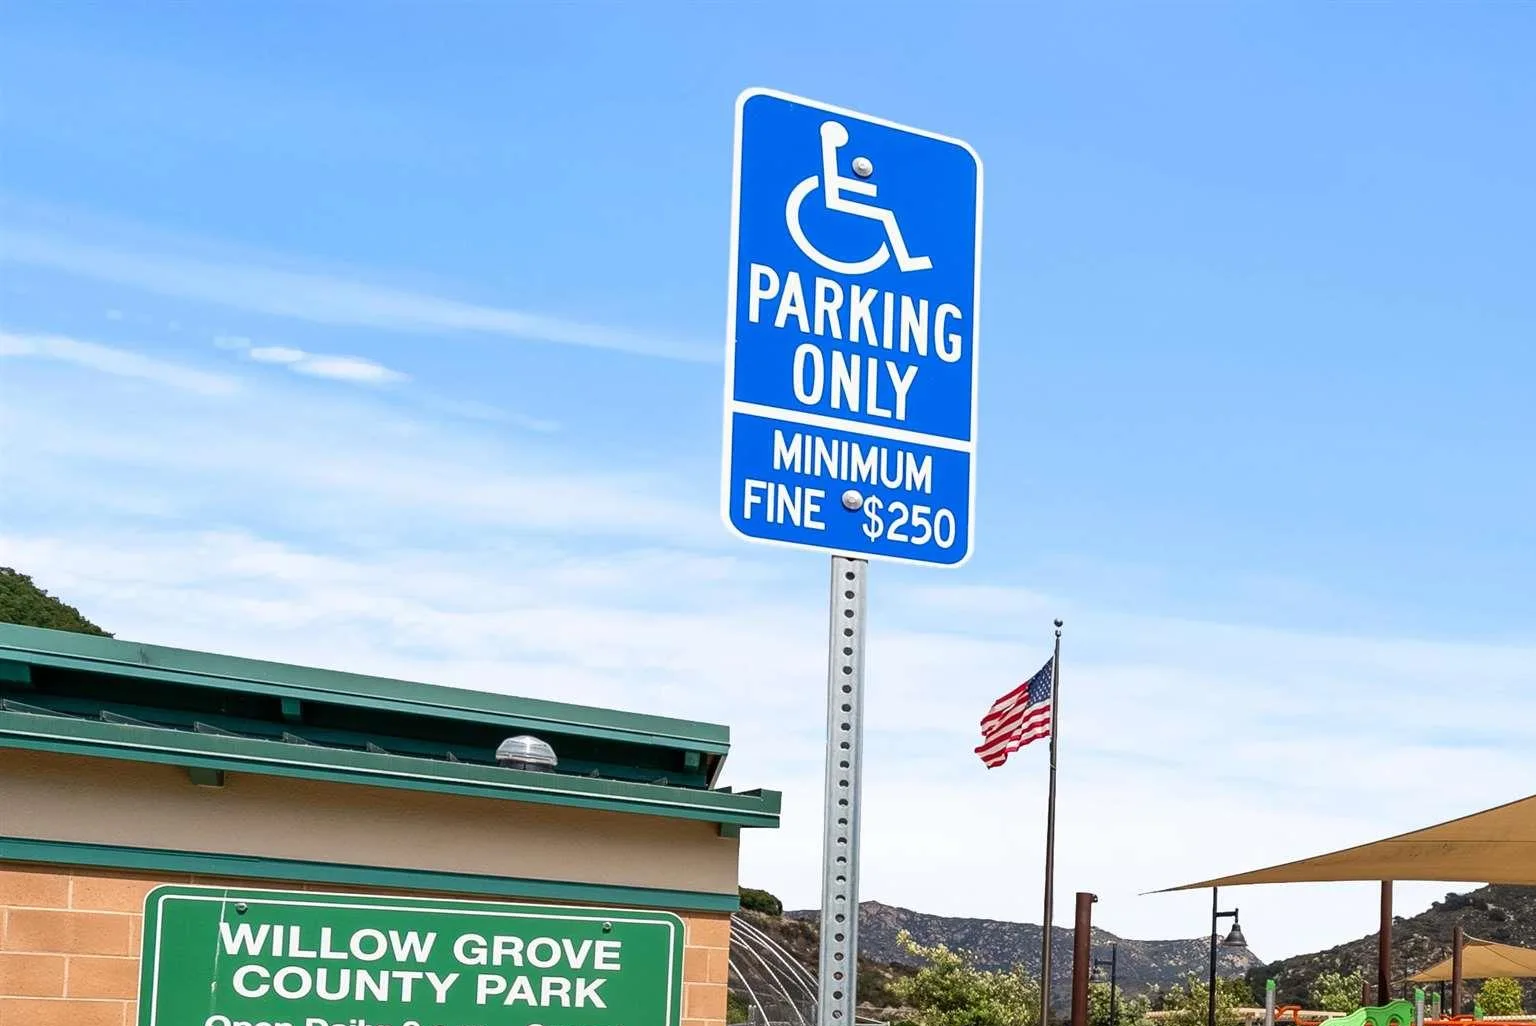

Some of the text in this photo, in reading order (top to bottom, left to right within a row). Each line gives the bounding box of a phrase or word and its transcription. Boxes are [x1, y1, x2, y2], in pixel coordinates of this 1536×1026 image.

[748, 263, 963, 364] PARKING
[792, 343, 919, 420] ONLY
[773, 430, 933, 494] MINIMUM
[744, 479, 955, 549] FINE $250
[220, 921, 622, 971] WILLOW GROVE
[232, 964, 608, 1009] COUNTY PARK
